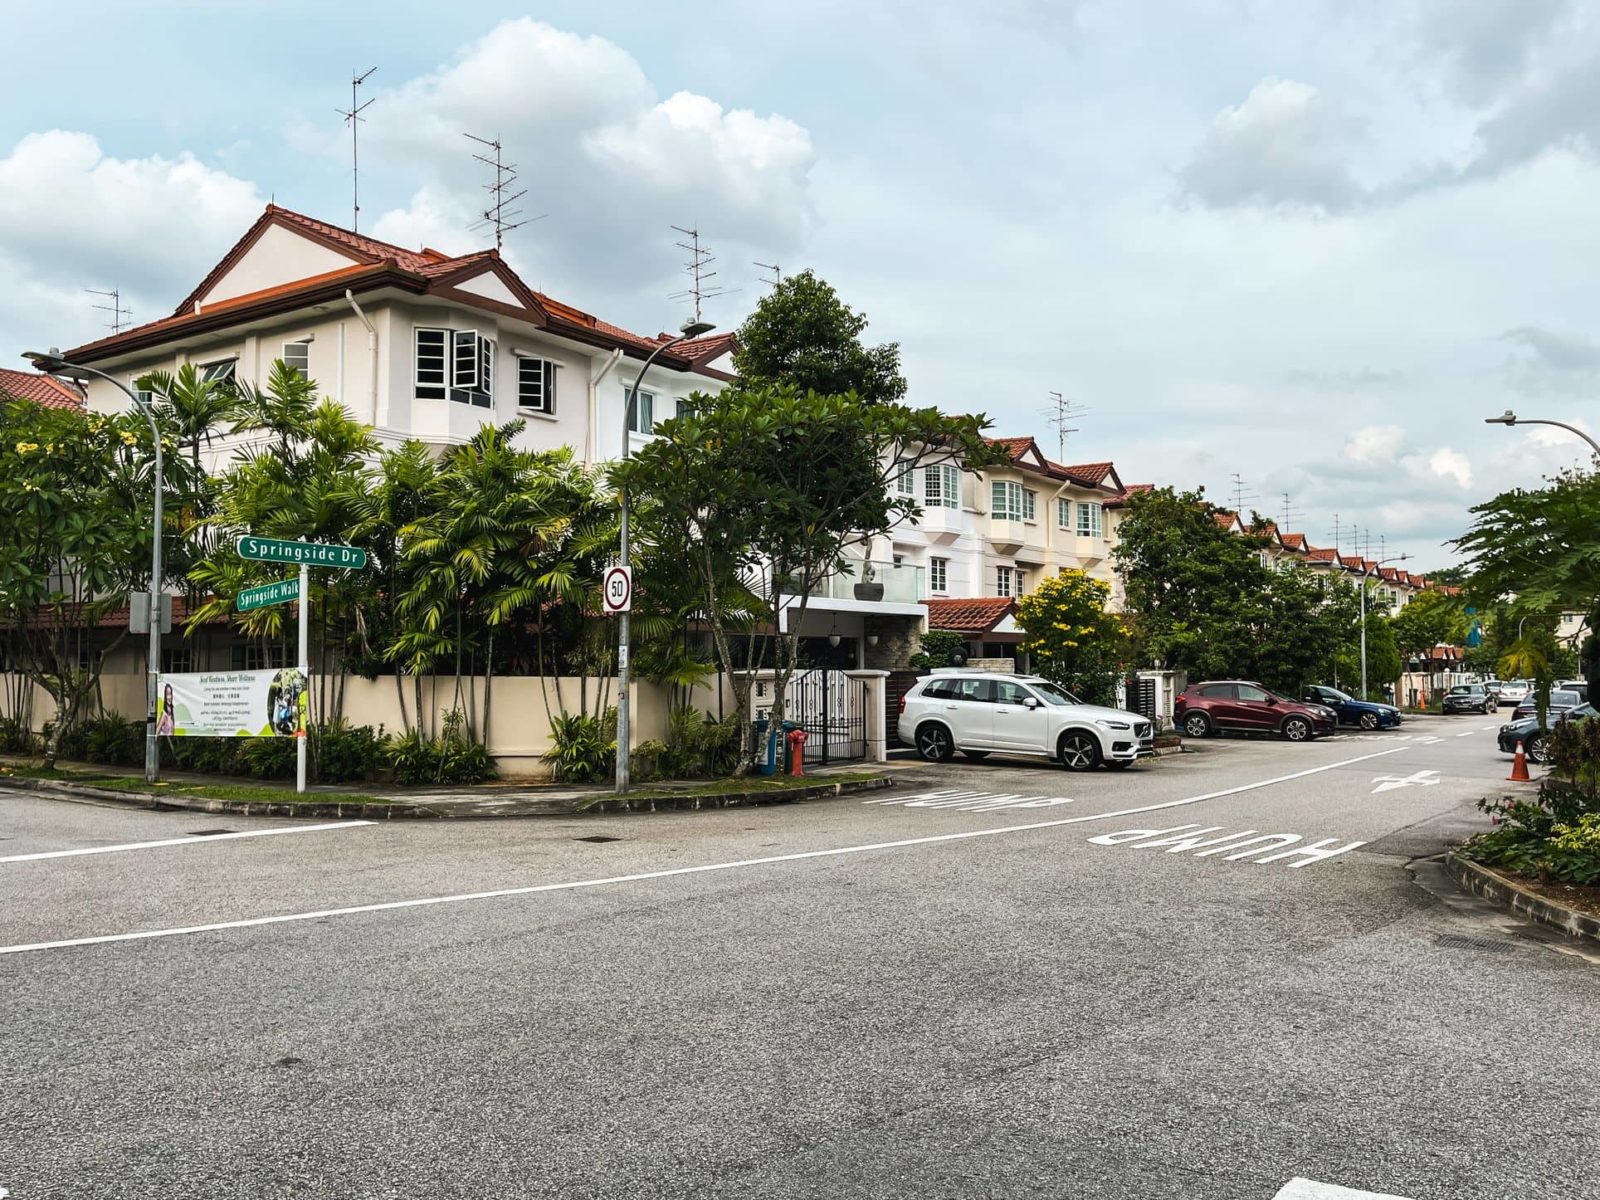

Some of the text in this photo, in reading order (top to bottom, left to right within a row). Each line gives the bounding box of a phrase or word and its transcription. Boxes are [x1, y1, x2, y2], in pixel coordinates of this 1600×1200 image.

[249, 540, 358, 563] Springside Dr
[240, 582, 299, 607] Springside Walk
[611, 581, 623, 597] 50
[861, 789, 1075, 813] HUMP
[1086, 823, 1369, 868] HUMP
